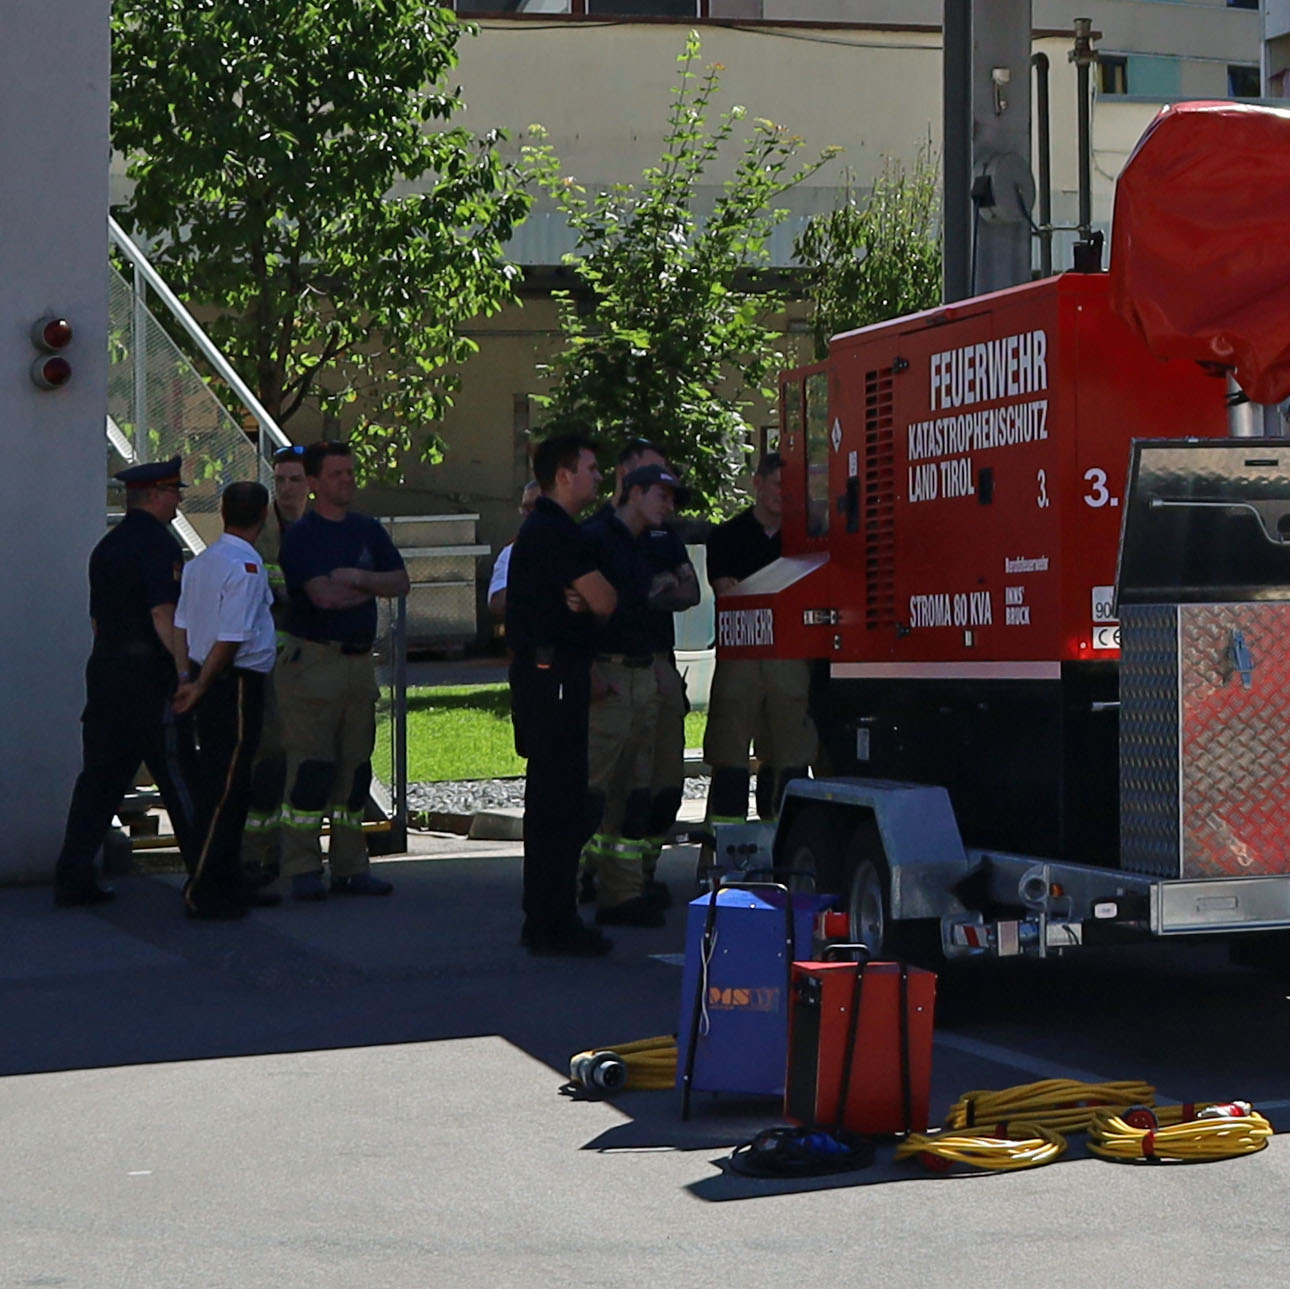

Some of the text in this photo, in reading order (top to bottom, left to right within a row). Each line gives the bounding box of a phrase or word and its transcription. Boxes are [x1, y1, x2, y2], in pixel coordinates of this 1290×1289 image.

[931, 330, 1047, 410] FEUERWEHR
[909, 400, 1047, 460] KATASTROPHENSCHUTZ
[909, 458, 974, 502] LAND TIROL
[1038, 470, 1050, 508] 3.
[1085, 468, 1118, 507] 3.
[719, 609, 773, 646] FEUERWEHR
[910, 592, 991, 627] STROMA 80 KVA
